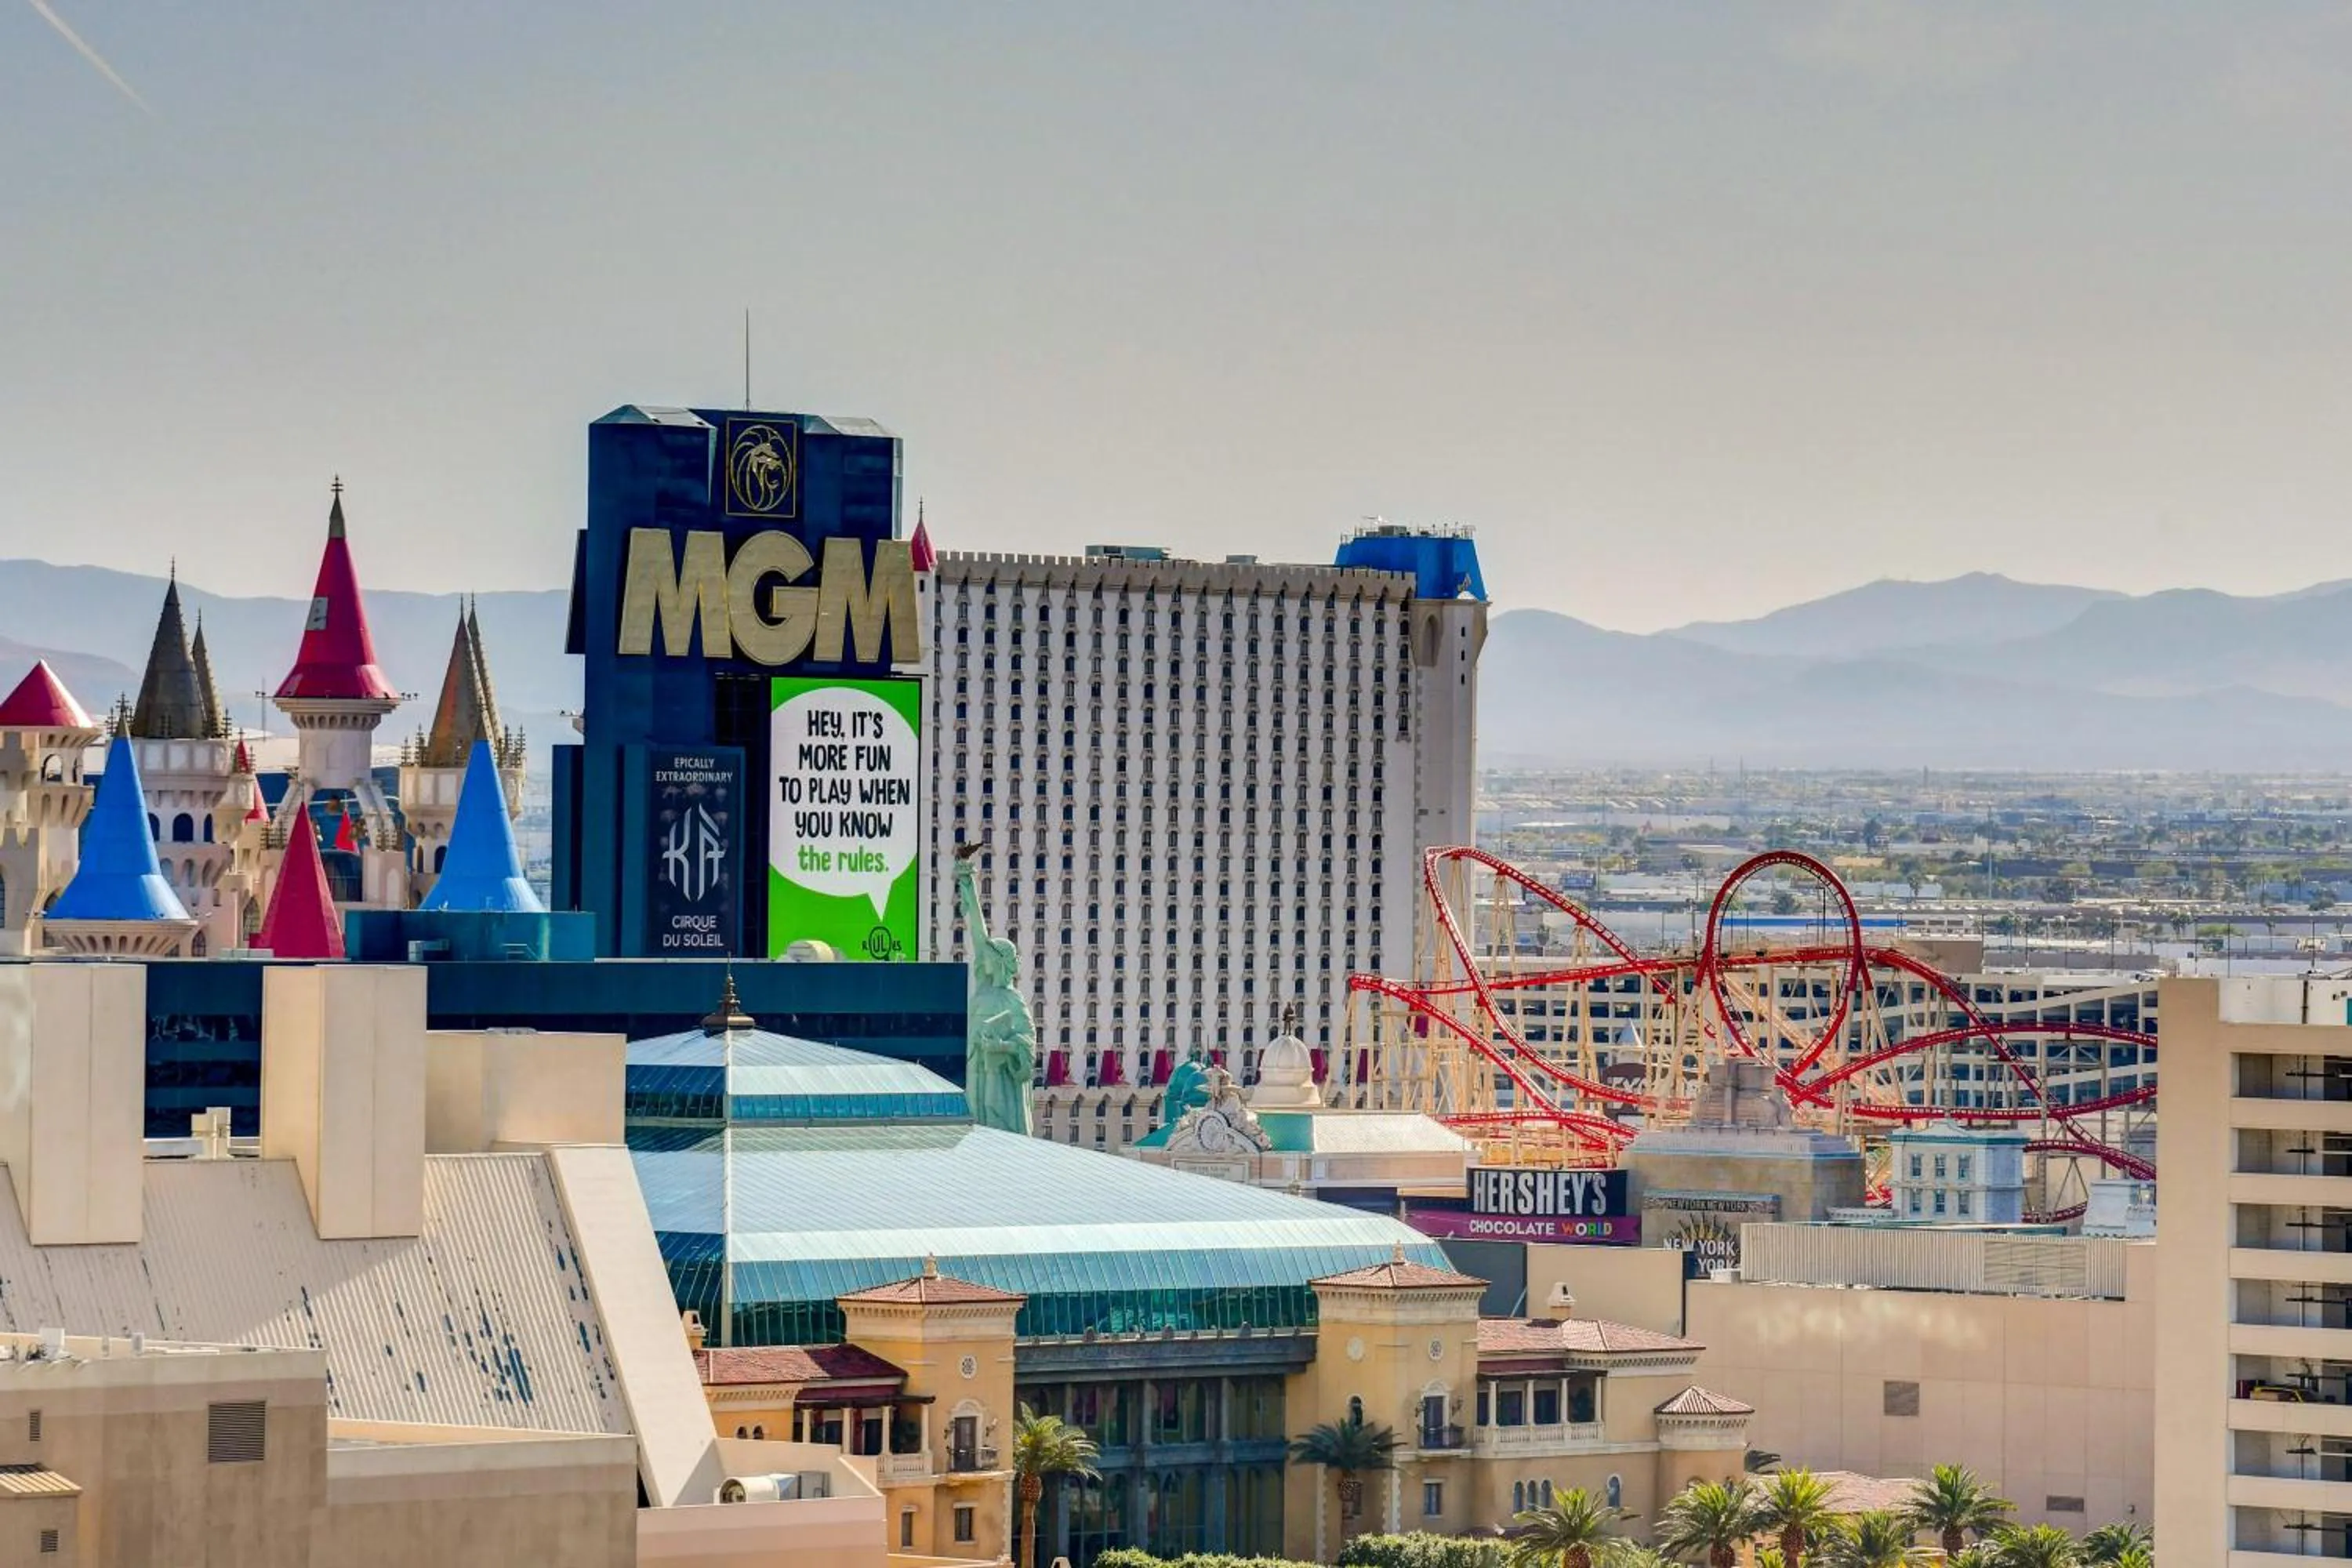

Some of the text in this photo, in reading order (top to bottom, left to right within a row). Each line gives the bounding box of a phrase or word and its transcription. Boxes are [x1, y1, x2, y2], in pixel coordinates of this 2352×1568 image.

[618, 527, 920, 666] MGM
[852, 710, 883, 739] IT'S
[673, 757, 715, 769] EPICALLY
[798, 743, 891, 771] MORE FUN
[655, 771, 733, 783] EXTRAORDINARY
[779, 776, 910, 805] TO PLAY WHEN
[794, 811, 893, 839] YOU KNOW
[797, 844, 889, 873] the rules.
[671, 915, 717, 932] CIRQUE
[662, 934, 724, 947] DU SOLEIL
[1473, 1171, 1607, 1216] HERSHEY'S
[1468, 1219, 1613, 1237] CHOCOLATE WORLD
[1663, 1238, 1735, 1256] NEW YORK
[1697, 1258, 1735, 1273] YORK
